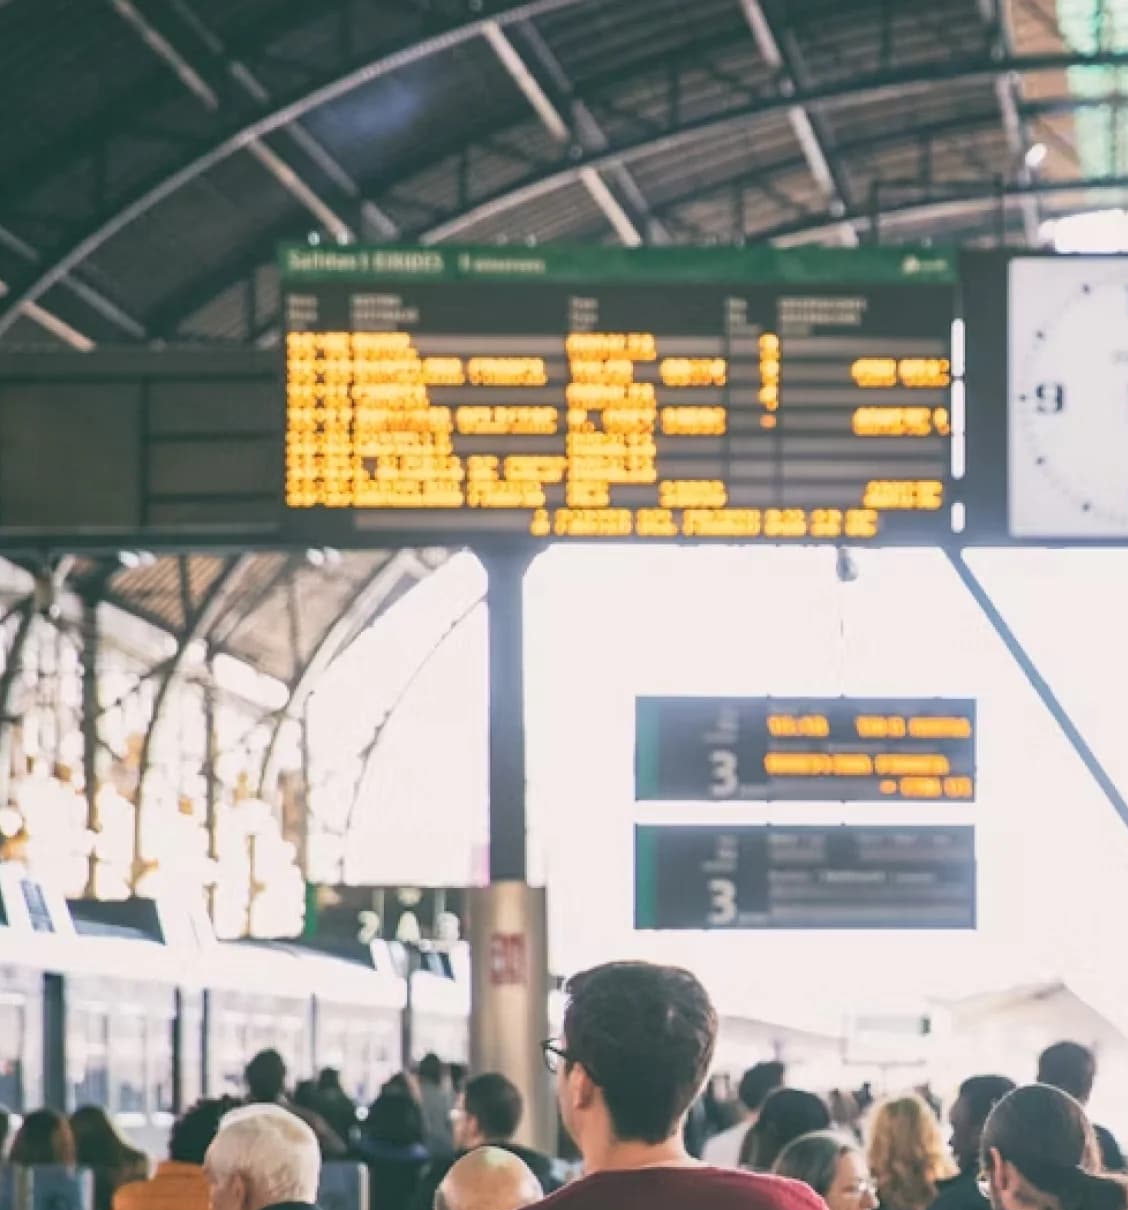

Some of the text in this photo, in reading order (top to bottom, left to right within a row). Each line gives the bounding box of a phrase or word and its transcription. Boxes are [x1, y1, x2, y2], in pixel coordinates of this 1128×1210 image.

[1036, 384, 1062, 412] 9
[709, 750, 737, 796] 3
[708, 879, 736, 925] 3
